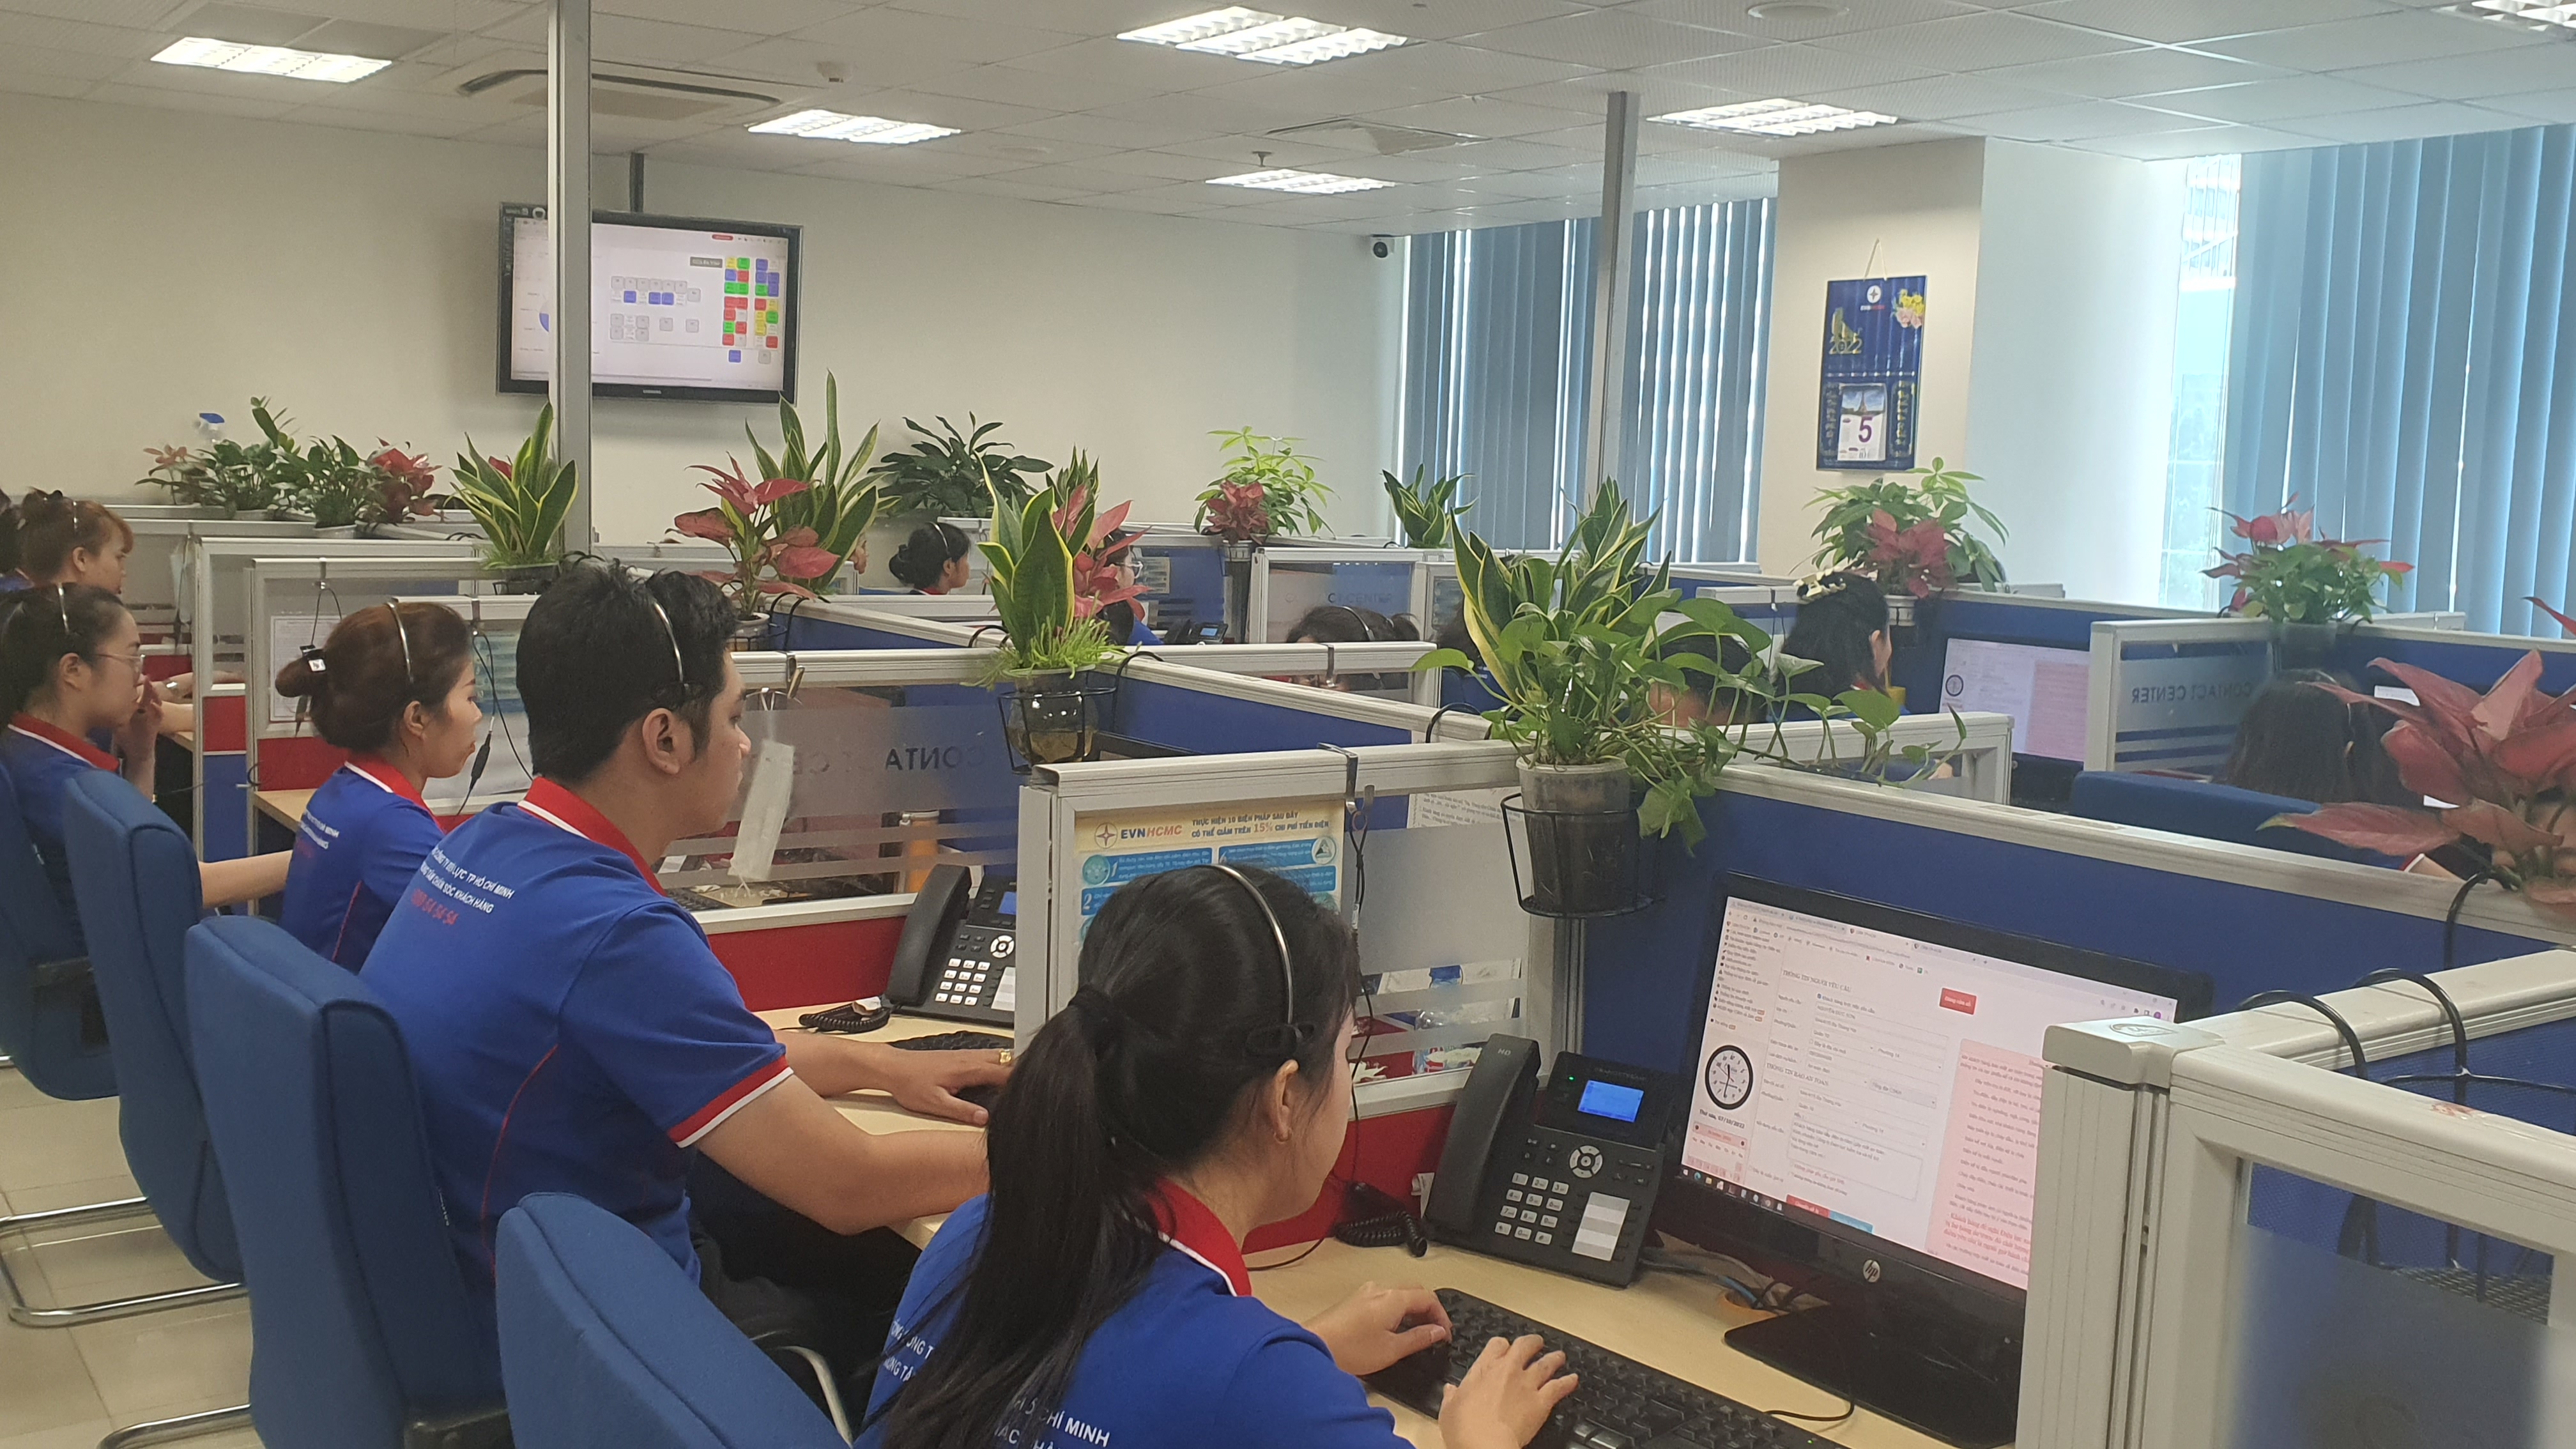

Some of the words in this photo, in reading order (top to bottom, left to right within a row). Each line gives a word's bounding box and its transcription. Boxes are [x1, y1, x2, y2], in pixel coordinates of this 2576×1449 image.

[1859, 416, 1873, 443] 5
[1254, 822, 1273, 833] 15%
[482, 880, 498, 891] CHÍ
[493, 884, 516, 900] MINH
[454, 889, 475, 906] KHÁCH
[473, 891, 495, 914] HÀNG
[1083, 893, 1092, 910] 2
[1864, 1259, 1879, 1281] hp
[924, 1345, 934, 1360] T
[1064, 1416, 1110, 1448] MINH
